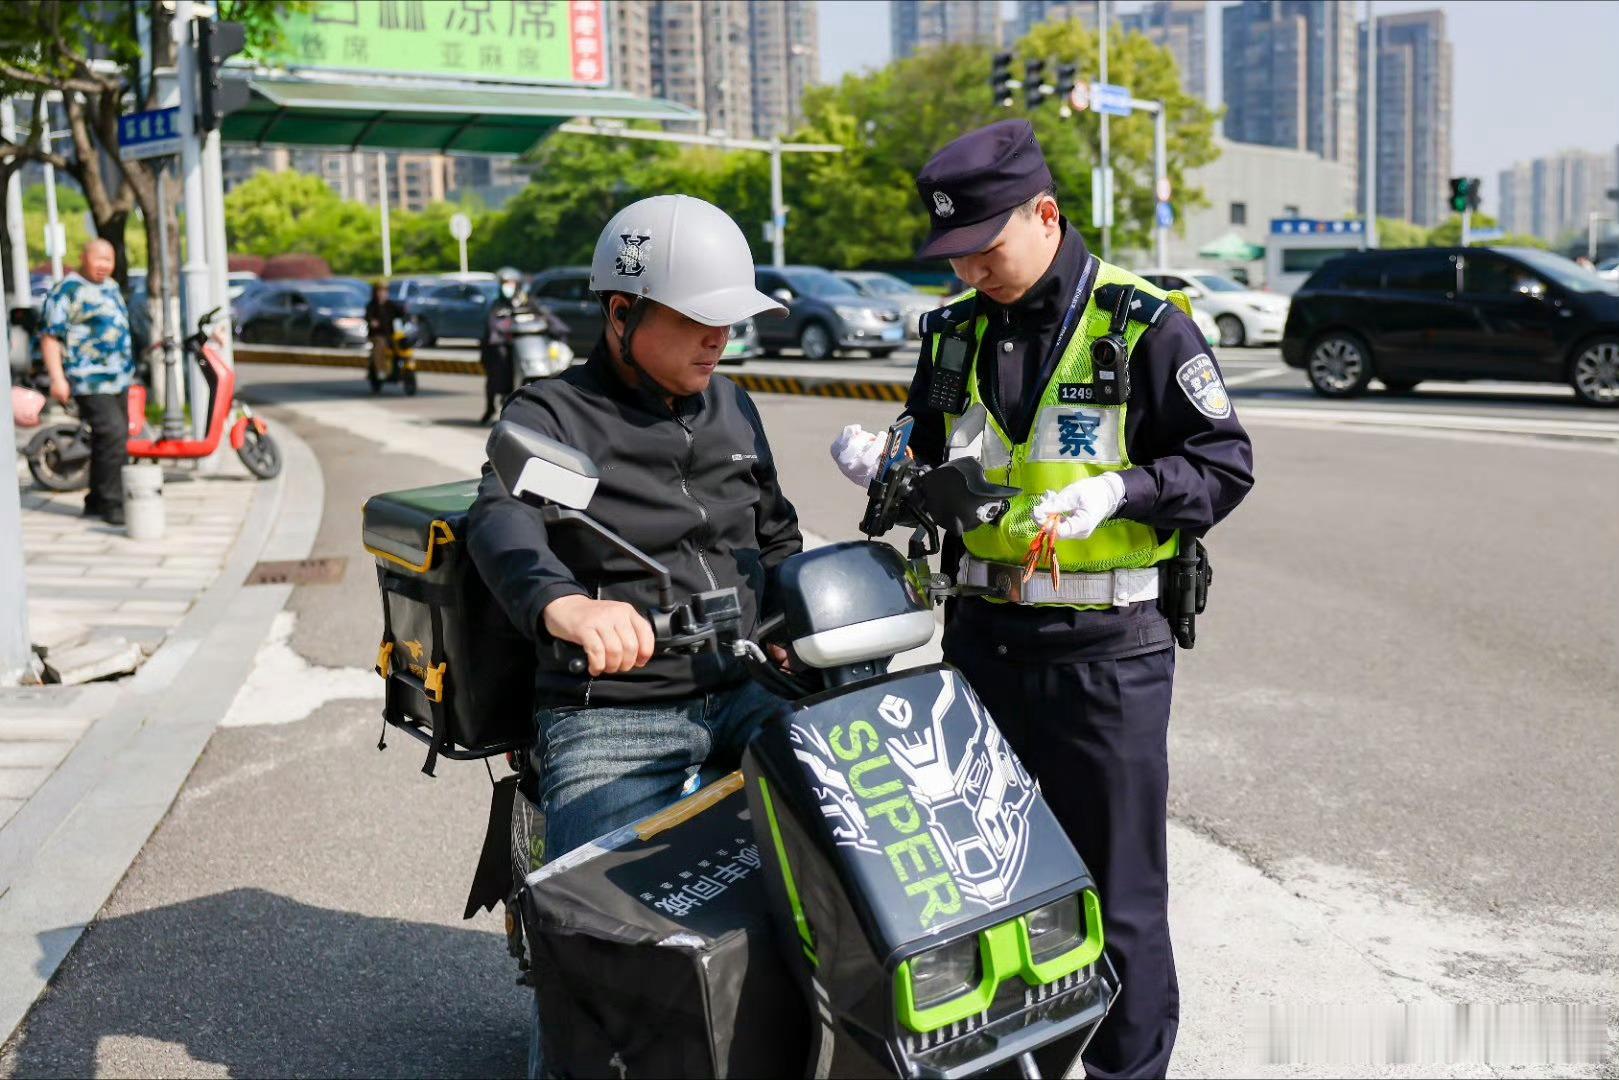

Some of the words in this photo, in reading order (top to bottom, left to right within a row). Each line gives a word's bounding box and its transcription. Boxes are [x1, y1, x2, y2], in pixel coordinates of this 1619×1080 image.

[1062, 386, 1093, 400] 1249
[1057, 411, 1100, 457] 察
[828, 720, 966, 928] SUPER
